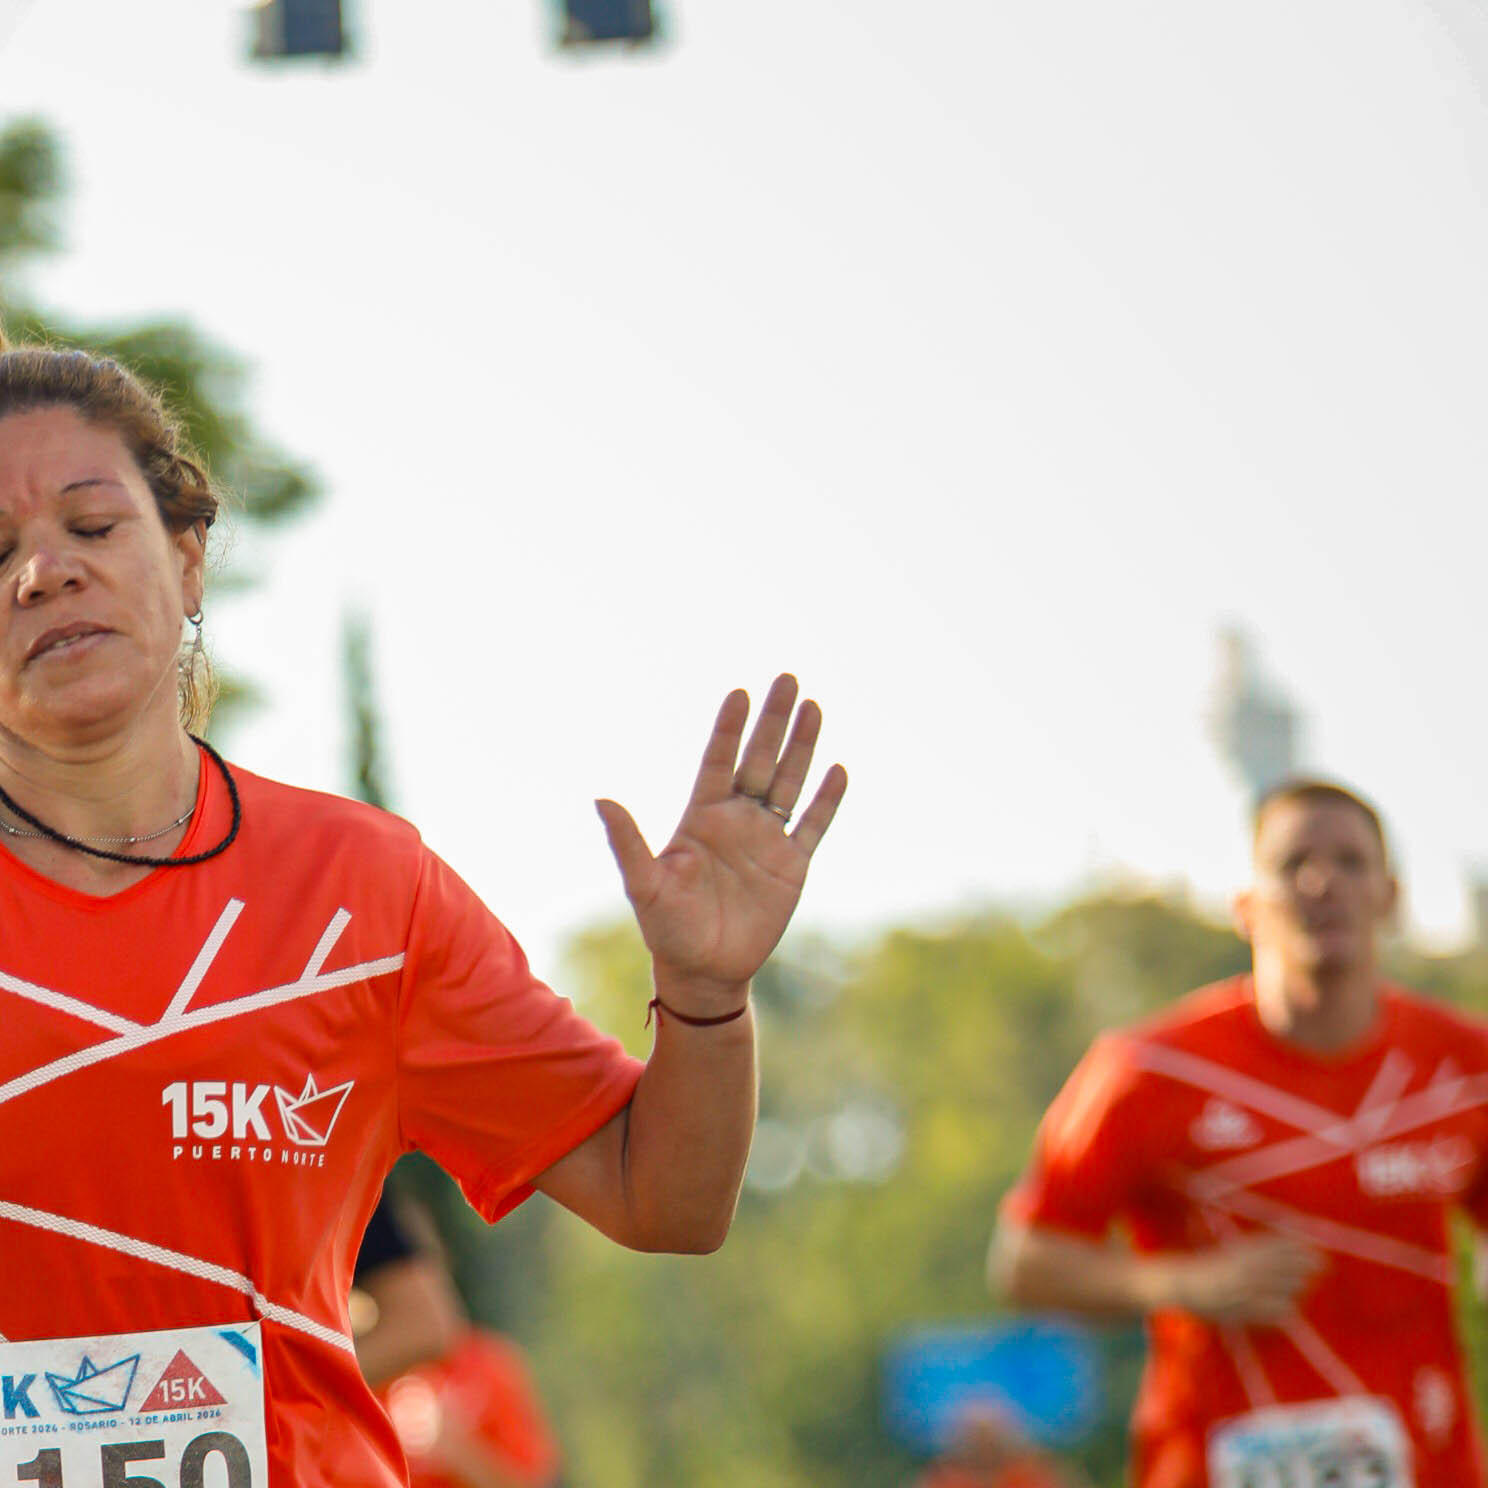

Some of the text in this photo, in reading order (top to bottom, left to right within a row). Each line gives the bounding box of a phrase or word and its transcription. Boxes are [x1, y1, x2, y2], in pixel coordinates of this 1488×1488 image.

[162, 1081, 272, 1141] 15K
[173, 1145, 326, 1168] PUERTO NORTE
[159, 1376, 209, 1403] 15K
[70, 1419, 117, 1433] ROSARIO
[129, 1417, 141, 1427] 12
[145, 1415, 159, 1425] DE
[162, 1412, 193, 1424] ABRIL
